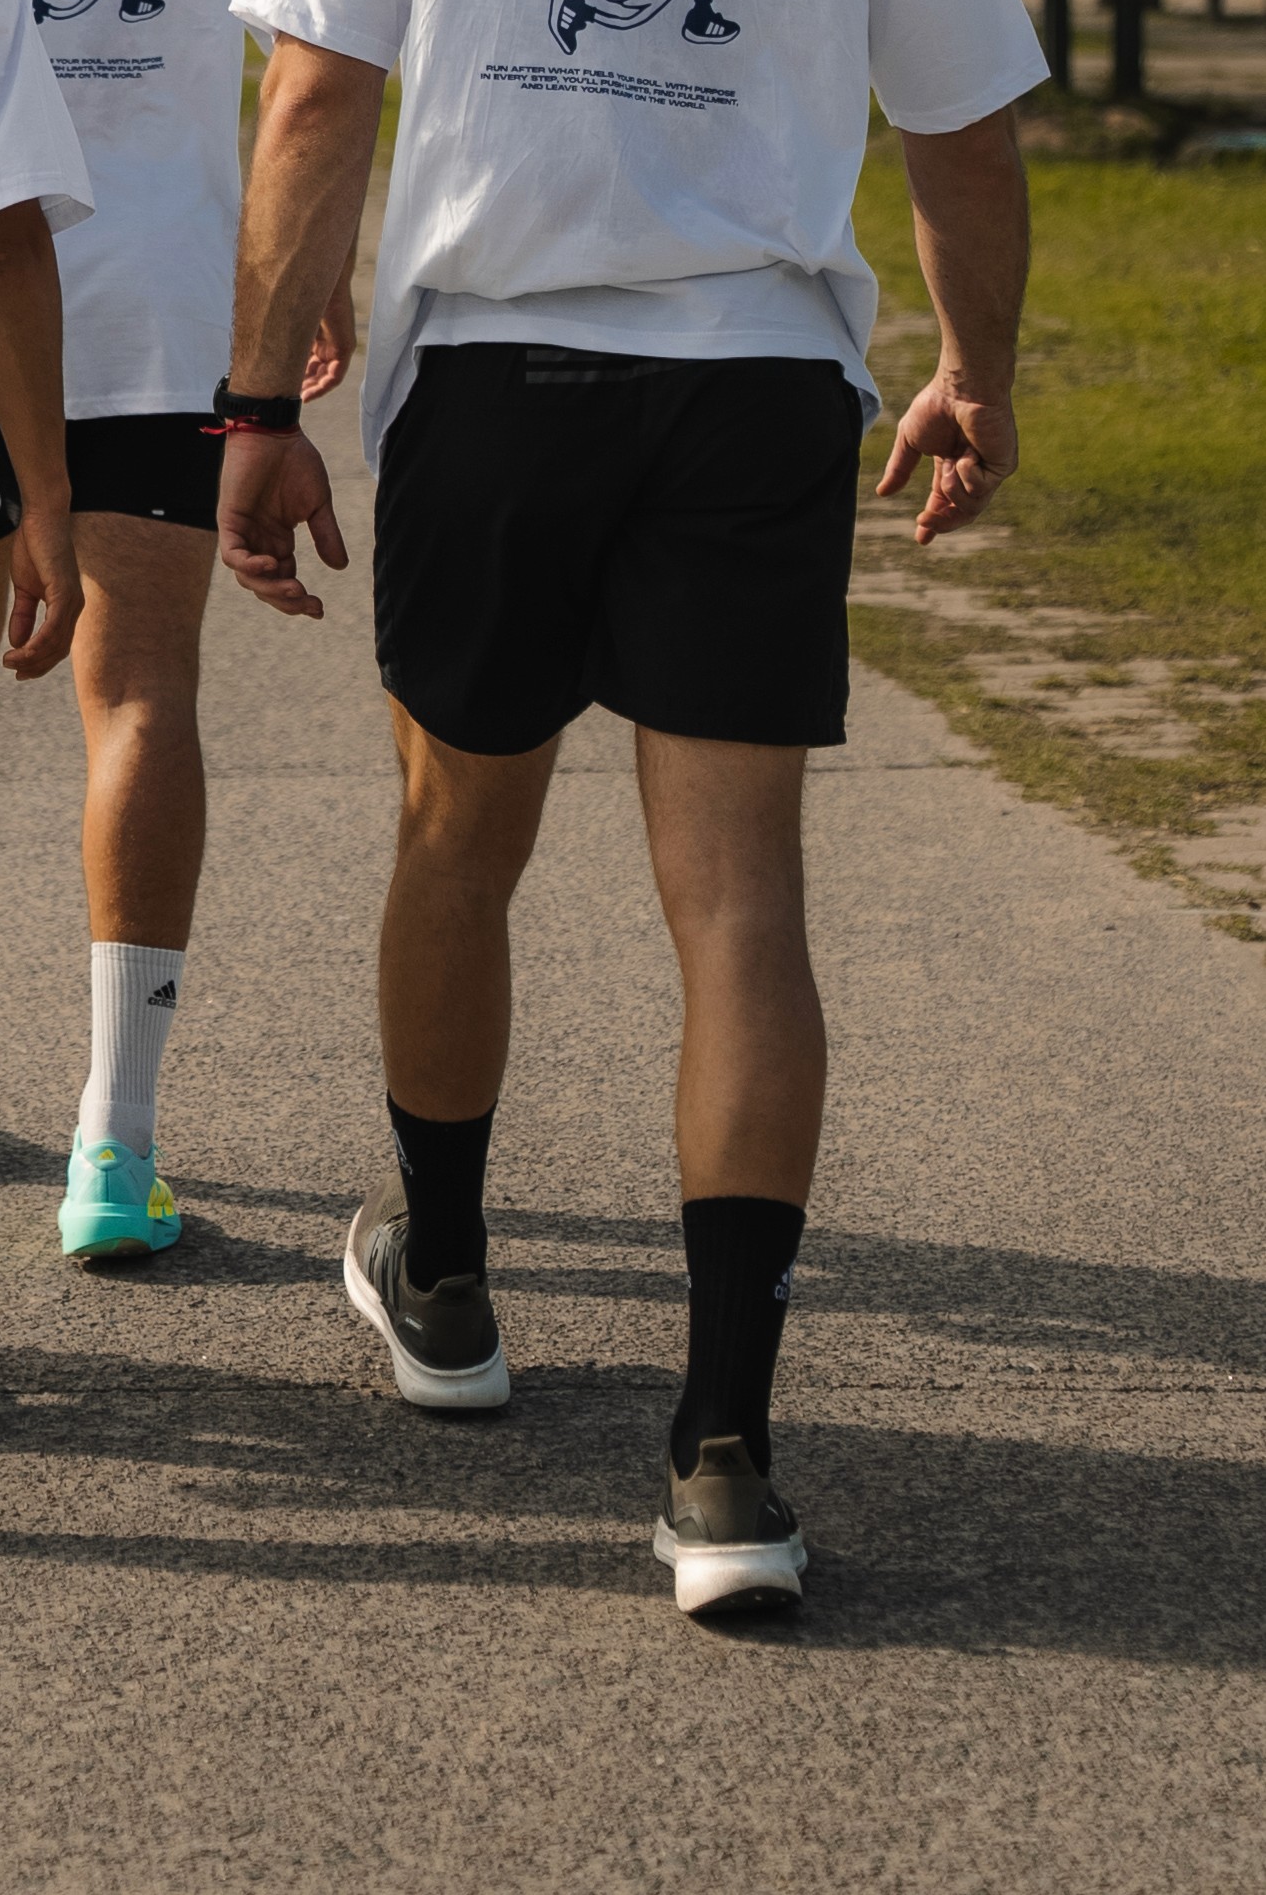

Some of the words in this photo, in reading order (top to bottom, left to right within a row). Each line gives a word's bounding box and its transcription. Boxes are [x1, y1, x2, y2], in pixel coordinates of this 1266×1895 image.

[511, 65, 545, 73] AFTER
[548, 67, 581, 75] WHAT
[583, 69, 615, 79] FUELS
[616, 73, 635, 83] YOUR
[665, 82, 693, 91] WITH
[694, 86, 736, 98] PURPOSE
[531, 75, 560, 84] STEP,
[562, 76, 598, 86] YOU'LL
[600, 80, 624, 88] PUSH
[653, 89, 675, 98] FIND
[545, 83, 578, 92] LEAVE
[582, 86, 610, 95] YOUR
[611, 89, 633, 99] MARK
[634, 94, 646, 102] ON
[648, 96, 666, 105] THE
[147, 996, 177, 1010] adida
